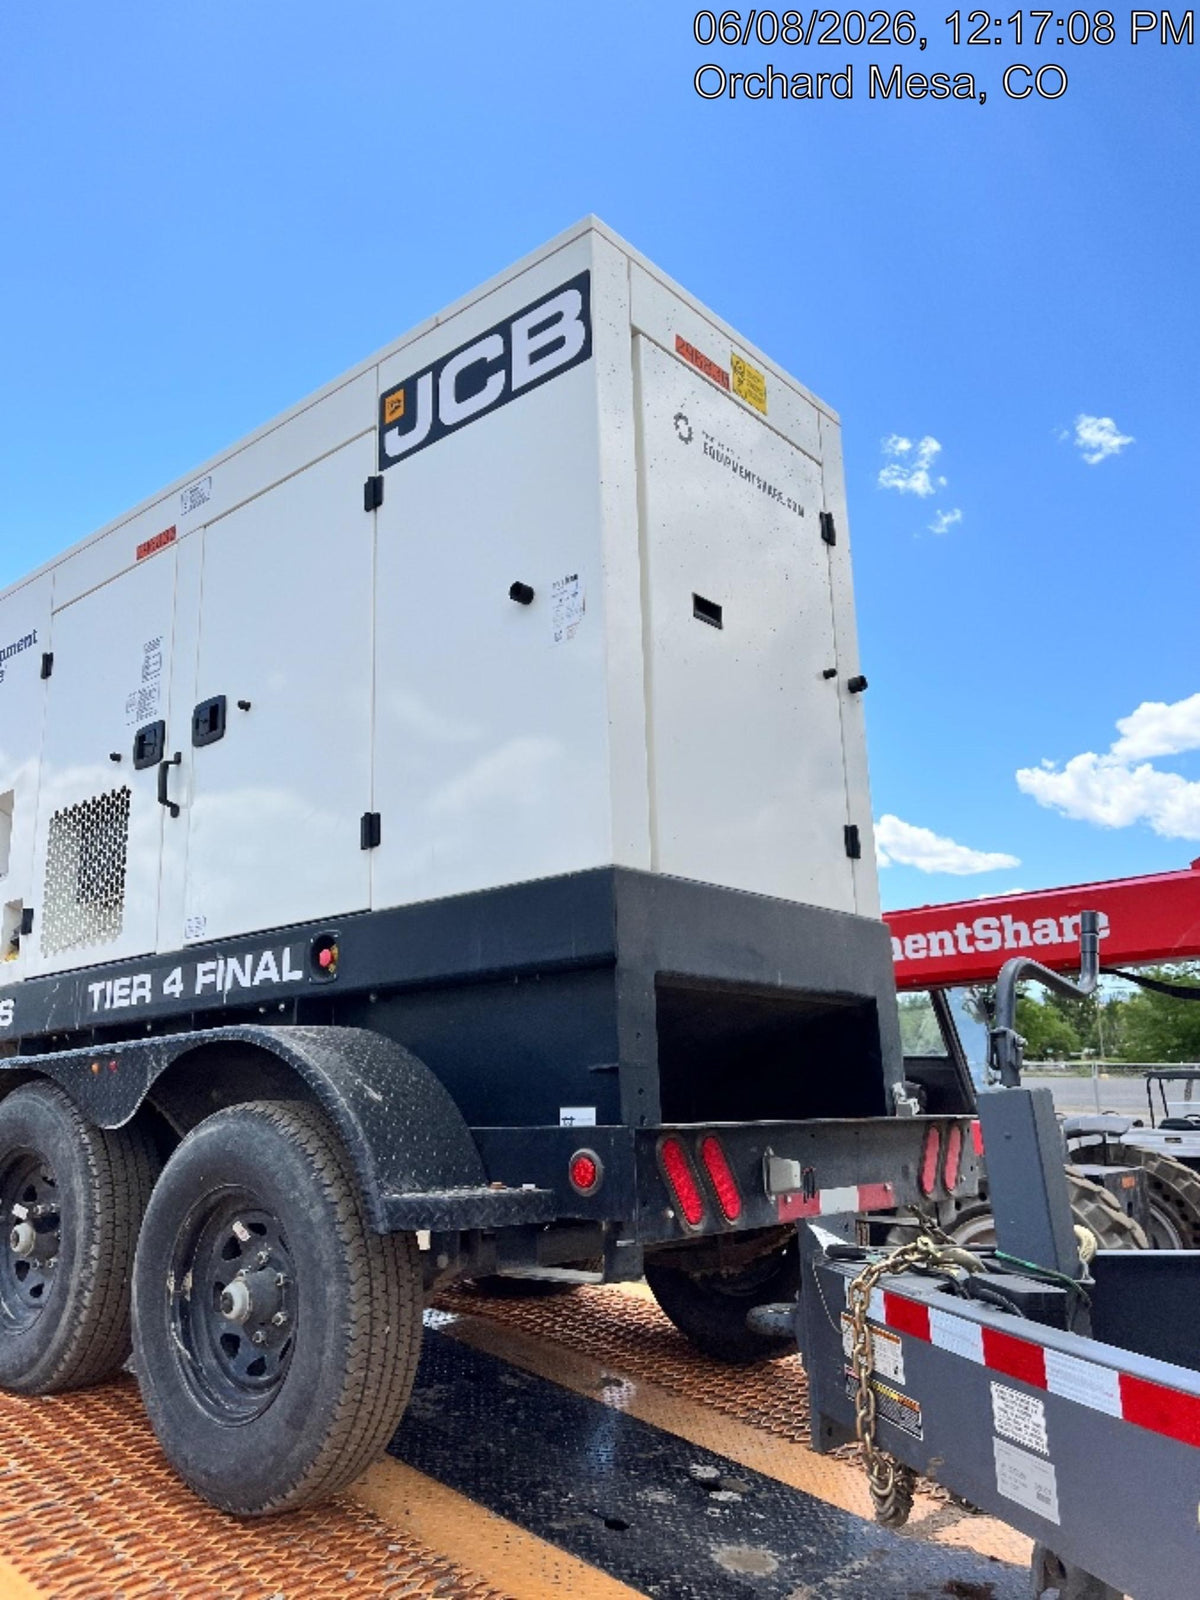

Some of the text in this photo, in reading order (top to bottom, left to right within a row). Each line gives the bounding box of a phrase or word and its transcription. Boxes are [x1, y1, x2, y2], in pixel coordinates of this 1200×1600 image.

[384, 289, 586, 458] JCB
[88, 947, 303, 1013] TIER 4 FINAL
